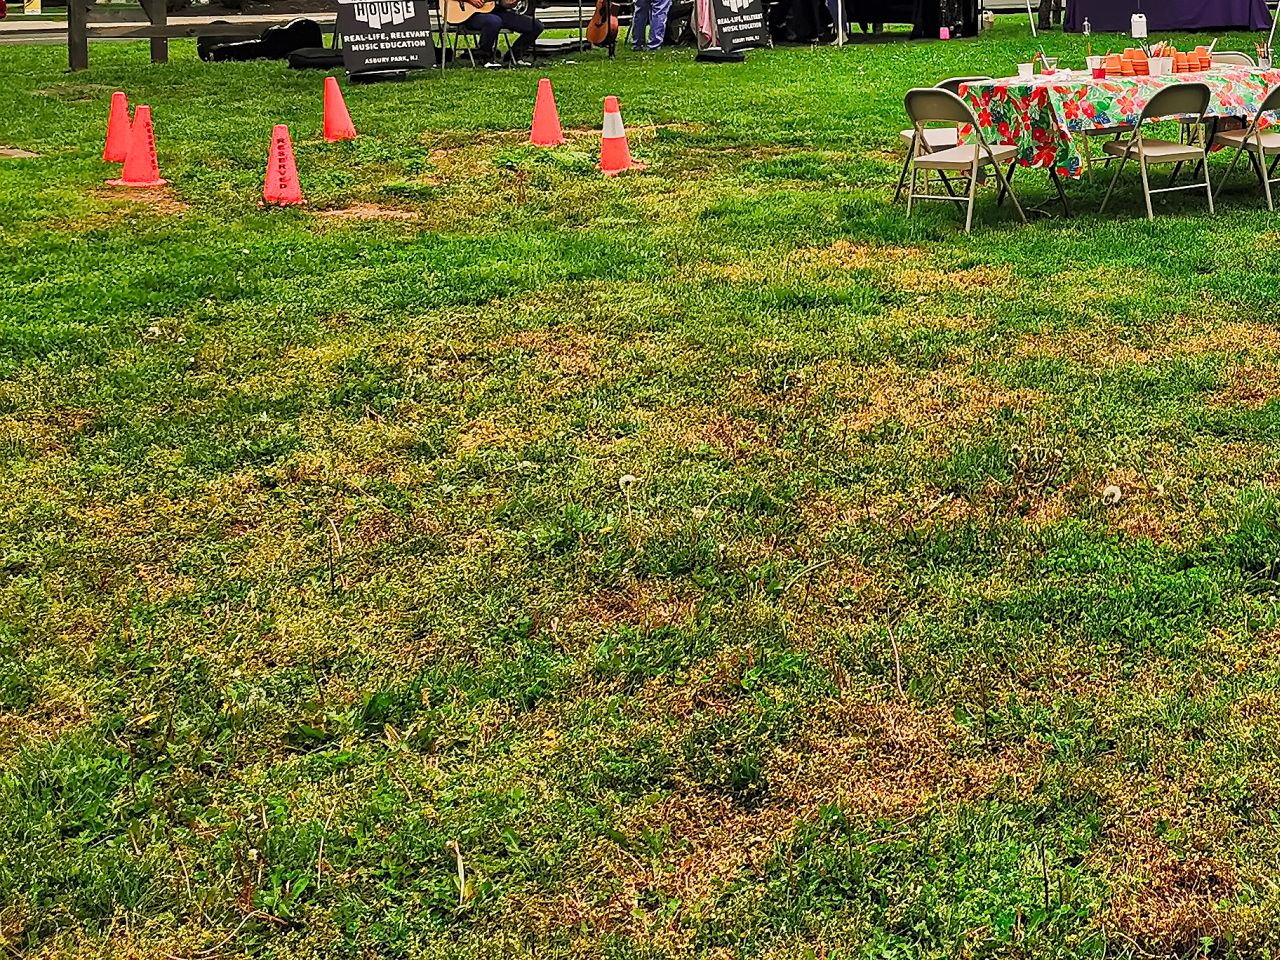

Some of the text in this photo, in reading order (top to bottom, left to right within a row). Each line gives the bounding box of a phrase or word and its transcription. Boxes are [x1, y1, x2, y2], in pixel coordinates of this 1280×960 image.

[356, 1, 413, 17] HOUSE
[343, 30, 431, 43] REAL-LIFE, RELEVANT
[351, 40, 426, 51] MUSIC EDUCATION
[364, 56, 390, 64] ASBURY
[276, 137, 288, 189] RESERVED
